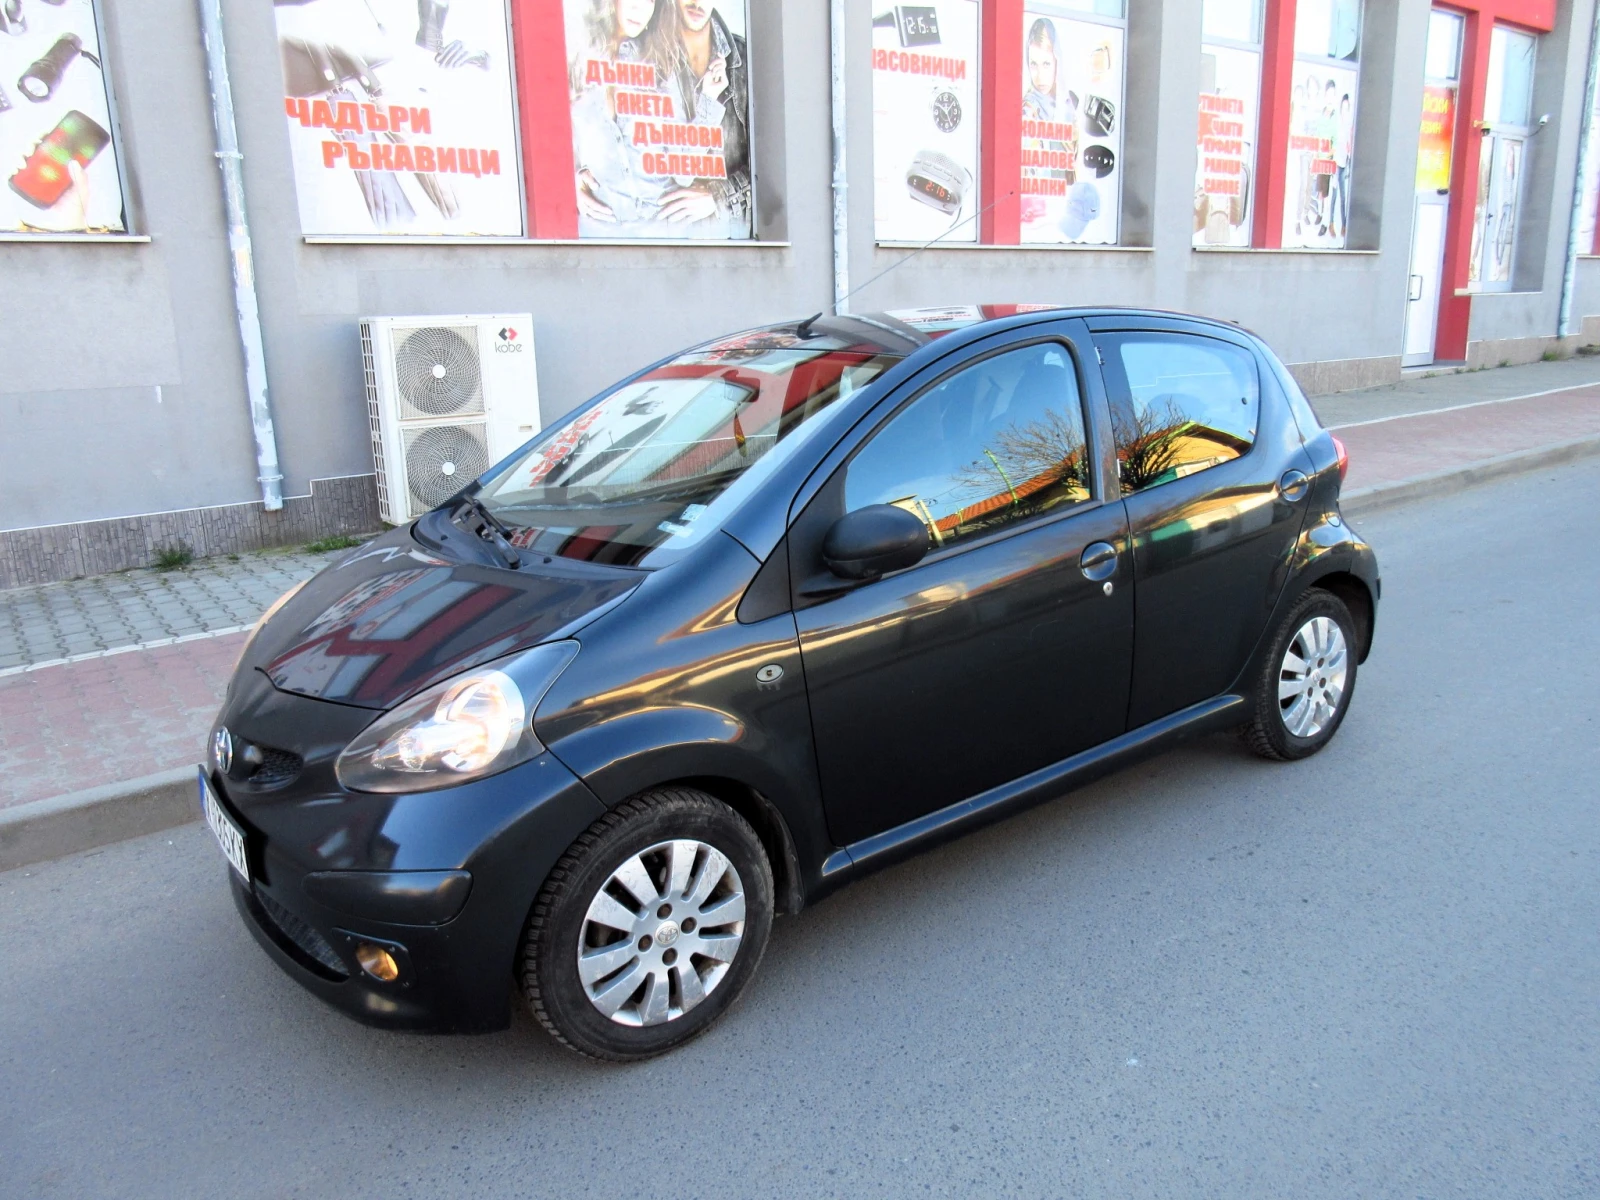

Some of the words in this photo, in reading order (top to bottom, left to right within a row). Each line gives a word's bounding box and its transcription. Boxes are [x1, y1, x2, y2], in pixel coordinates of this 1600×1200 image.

[586, 59, 655, 87] ДЪНКИ
[284, 97, 432, 134] ЧАДЪРИ
[617, 92, 674, 118] ЯКЕТА
[633, 122, 722, 148] ДЪНКОВИ
[321, 141, 500, 178] РЪКАВИЦИ
[642, 152, 726, 178] ОБЛЕКЛА
[494, 341, 522, 353] kobe
